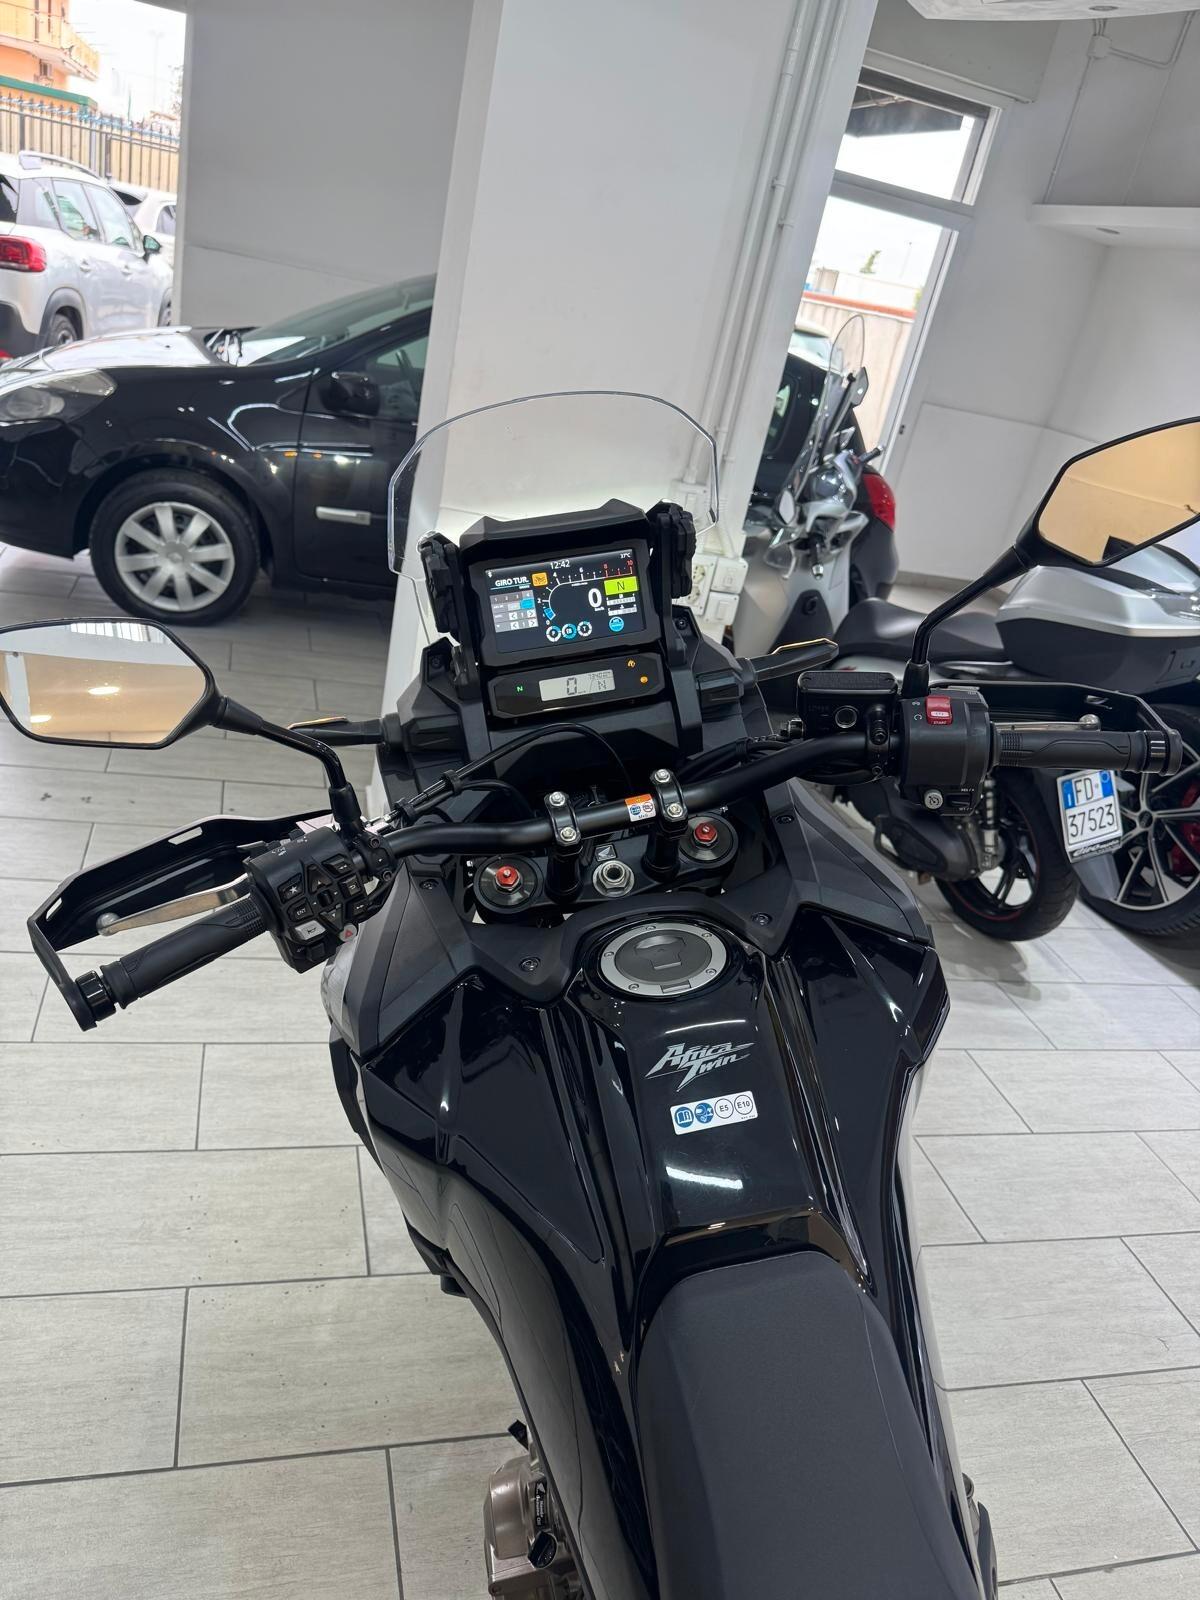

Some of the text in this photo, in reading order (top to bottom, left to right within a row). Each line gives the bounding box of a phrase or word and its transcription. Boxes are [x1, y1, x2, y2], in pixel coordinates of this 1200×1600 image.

[550, 560, 571, 570] 12:42
[495, 576, 530, 587] GIRO TUR.
[616, 581, 625, 591] N
[588, 588, 602, 608] 0
[566, 677, 577, 696] 0
[1074, 777, 1094, 804] FD
[1068, 803, 1115, 838] 37523
[645, 1042, 755, 1078] Africa
[676, 1053, 751, 1092] Twin
[719, 1104, 729, 1112] E5
[736, 1100, 751, 1109] E10
